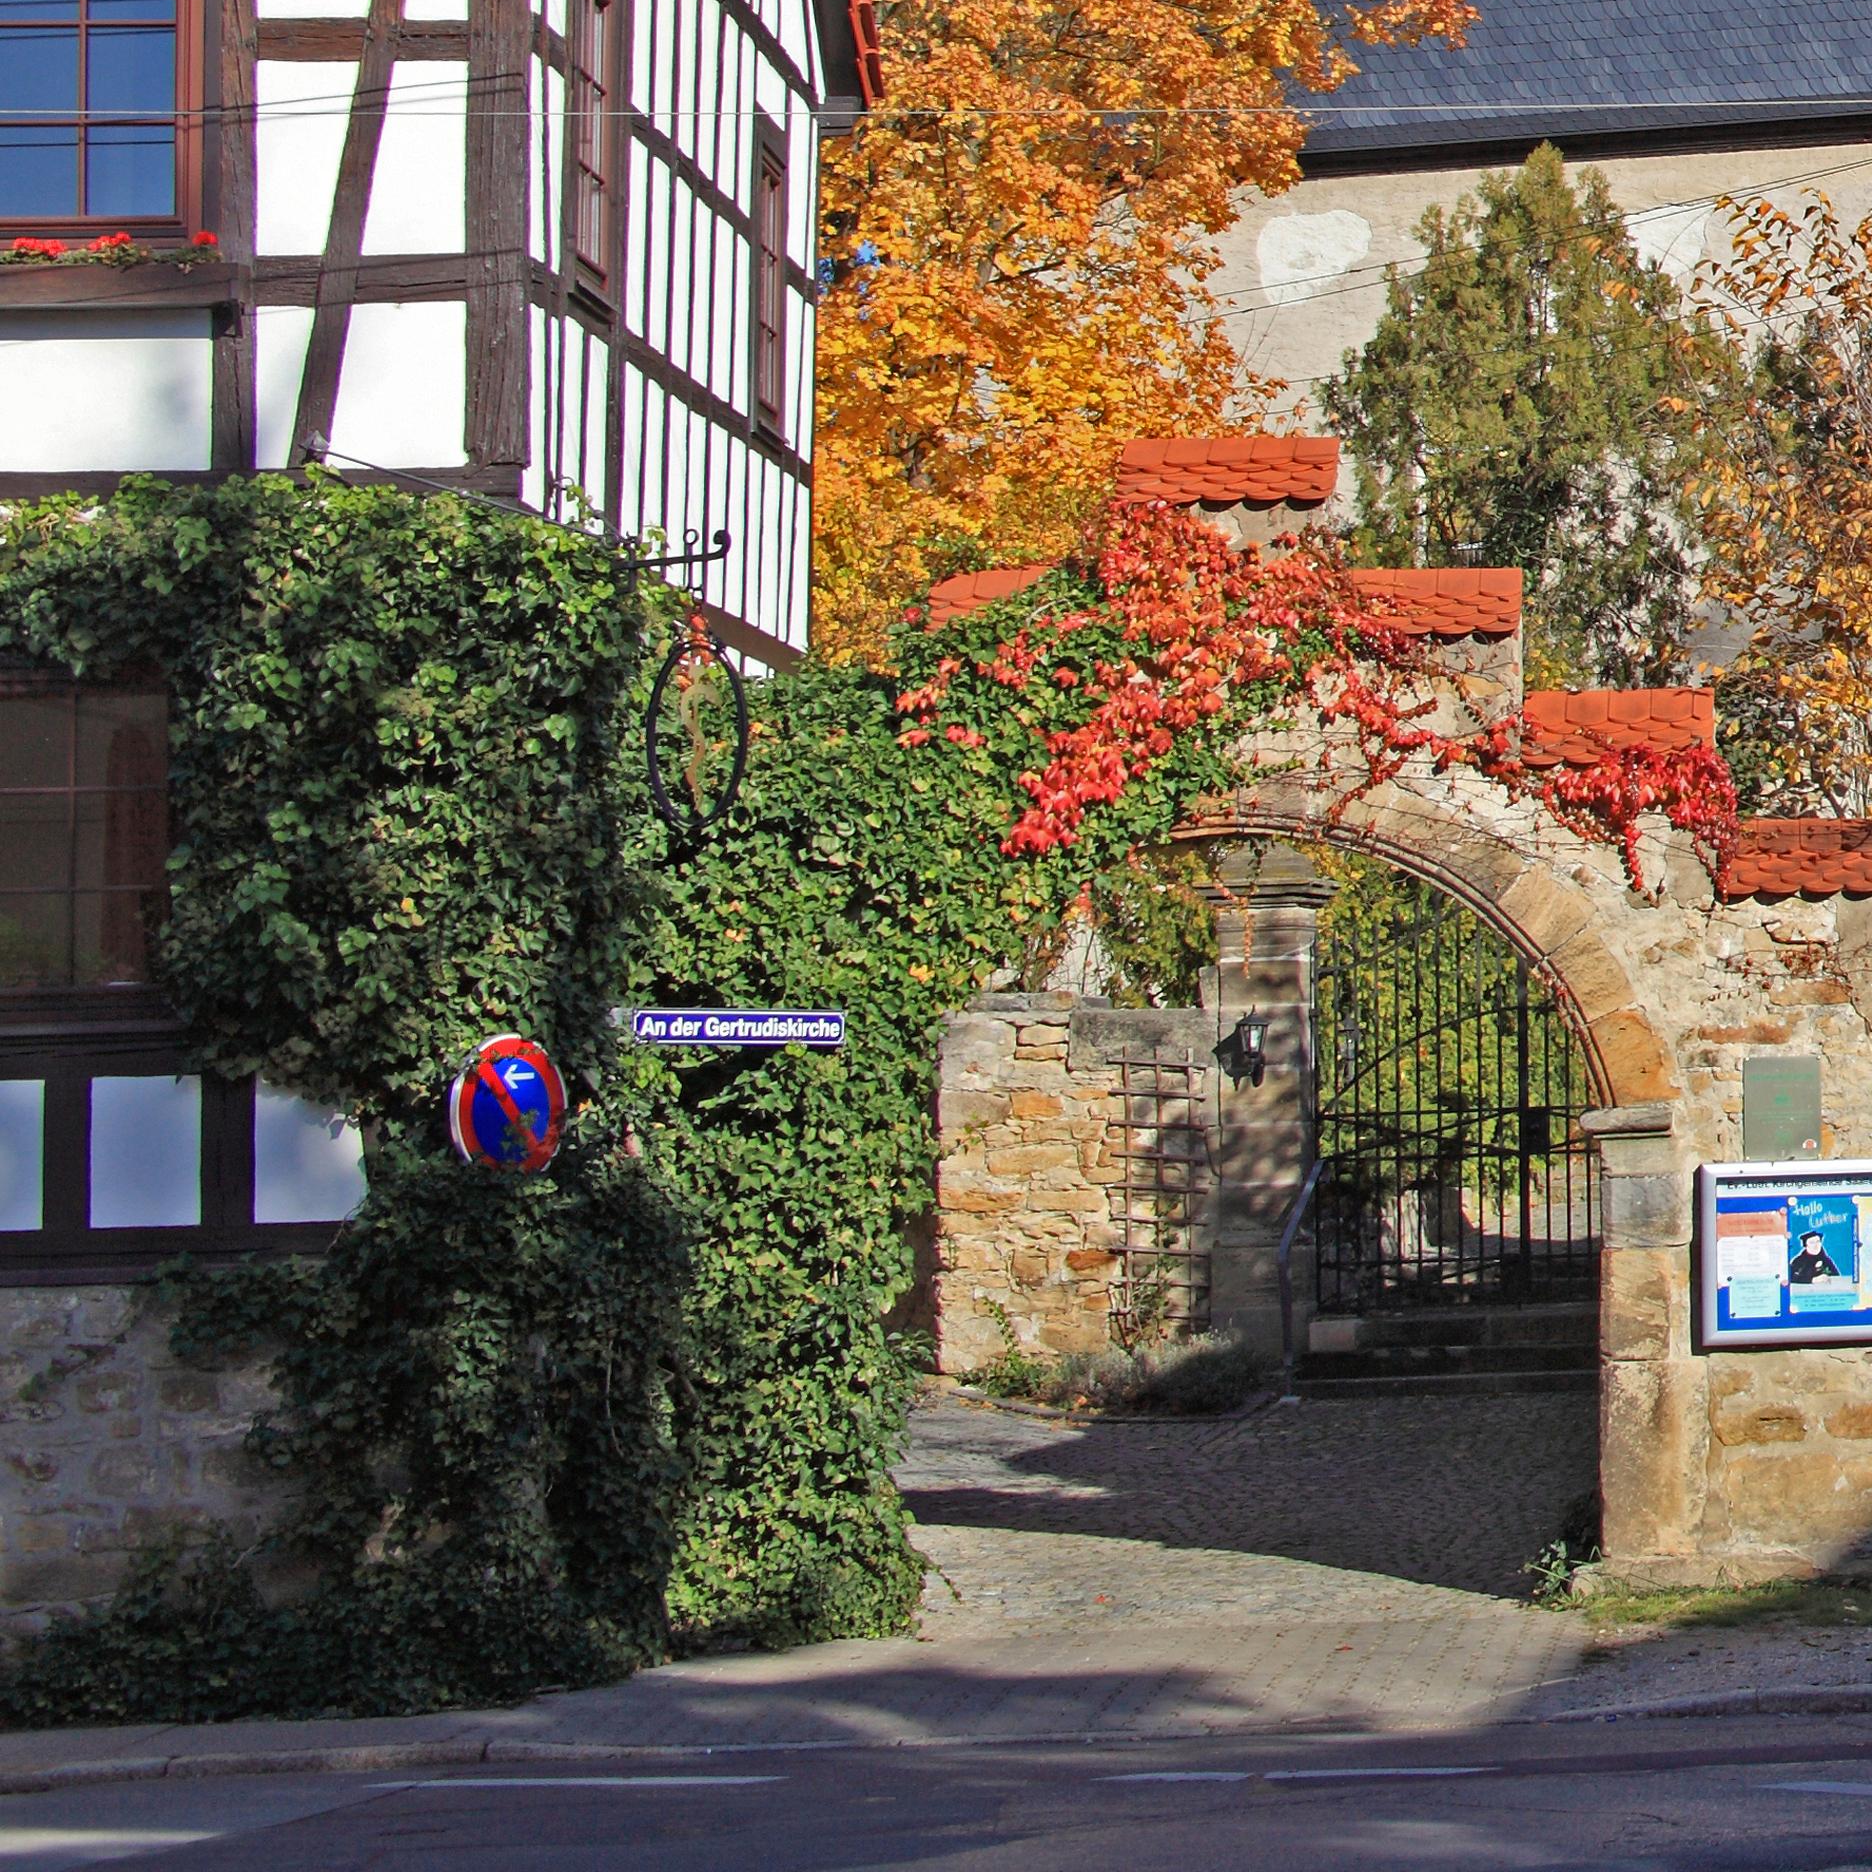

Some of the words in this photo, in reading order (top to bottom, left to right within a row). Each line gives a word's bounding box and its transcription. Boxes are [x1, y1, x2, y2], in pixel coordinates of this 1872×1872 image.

[640, 1017, 666, 1036] An
[669, 1017, 702, 1036] der
[705, 1017, 840, 1037] Gertrudiskirche
[1793, 1200, 1823, 1216] Hallo
[1809, 1211, 1848, 1228] Luther
